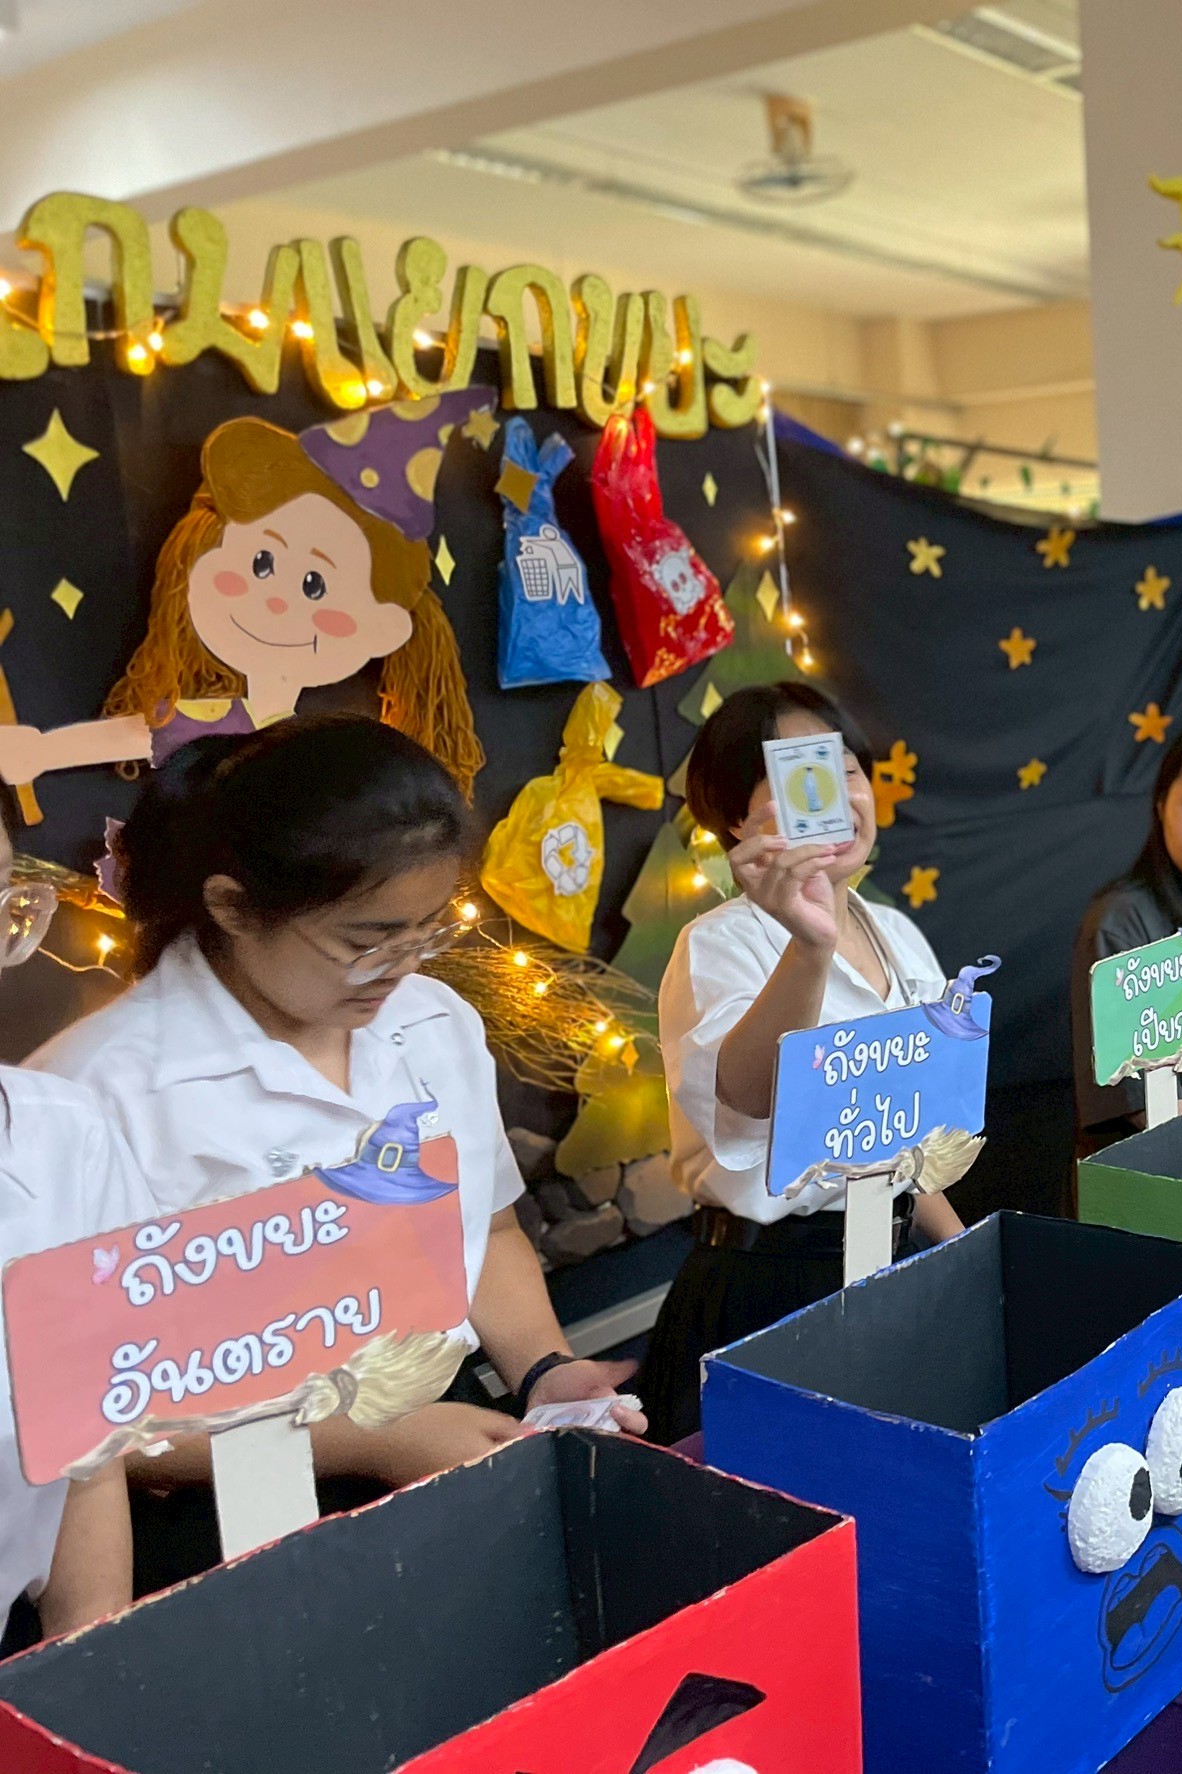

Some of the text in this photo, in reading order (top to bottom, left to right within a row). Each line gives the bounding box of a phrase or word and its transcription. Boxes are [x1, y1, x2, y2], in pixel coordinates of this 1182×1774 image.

[823, 1030, 931, 1086] ถังขยะ
[824, 1087, 922, 1158] ทั่วไป
[120, 1200, 349, 1307] ถังขยะ
[101, 1287, 382, 1425] อันตราย
